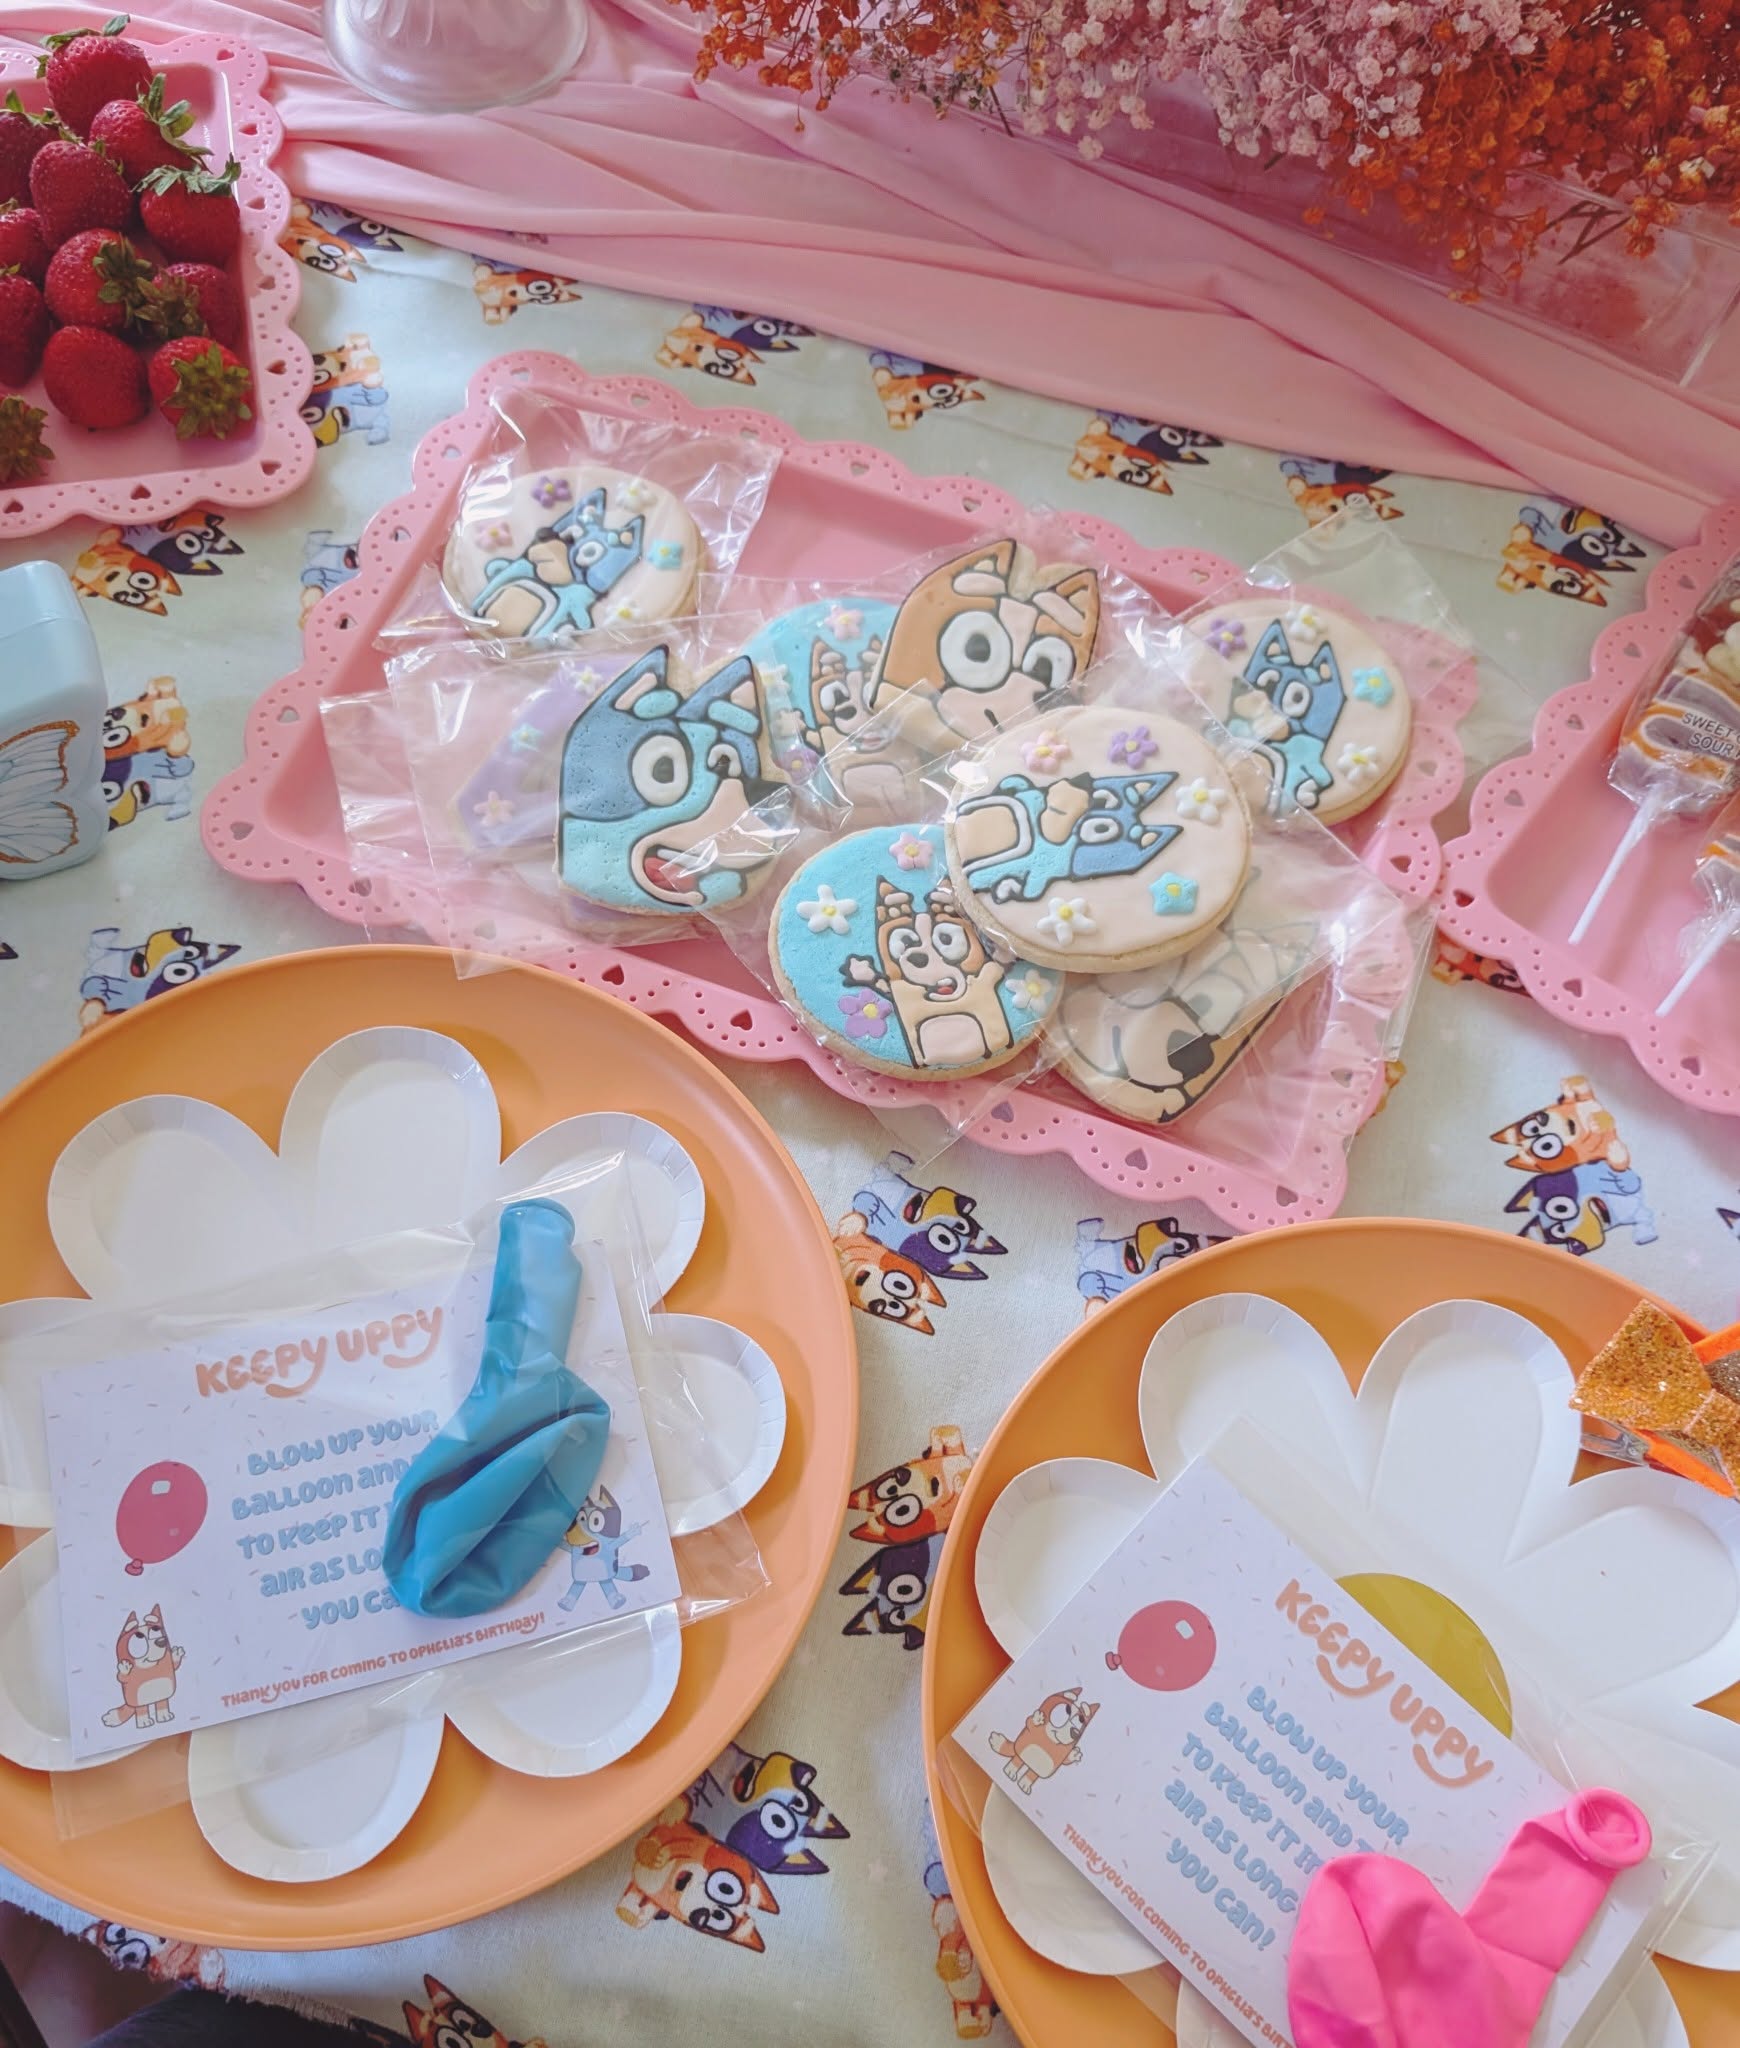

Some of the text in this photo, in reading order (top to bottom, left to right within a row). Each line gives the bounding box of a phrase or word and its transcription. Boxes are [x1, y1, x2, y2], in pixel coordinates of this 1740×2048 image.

[1682, 712, 1733, 739] SWEET
[1690, 732, 1734, 757] SOUR
[195, 1306, 443, 1398] KEEPY UPPY
[247, 1409, 440, 1476] BLOW UP YOUR
[236, 1532, 275, 1559] TO
[351, 1505, 381, 1532] IT
[347, 1545, 385, 1575] LO
[302, 1595, 359, 1630] YOU
[302, 1671, 329, 1688] FOR
[388, 1650, 408, 1666] TO
[1275, 1578, 1495, 1789] KEEPY UPPY
[1181, 1732, 1214, 1771] TO
[1266, 1818, 1300, 1852] IT
[1247, 1686, 1410, 1846] BLOW UP YOUR
[1166, 1837, 1219, 1894] YOU
[1120, 1884, 1146, 1912] FOR
[1190, 1951, 1208, 1973] TO
